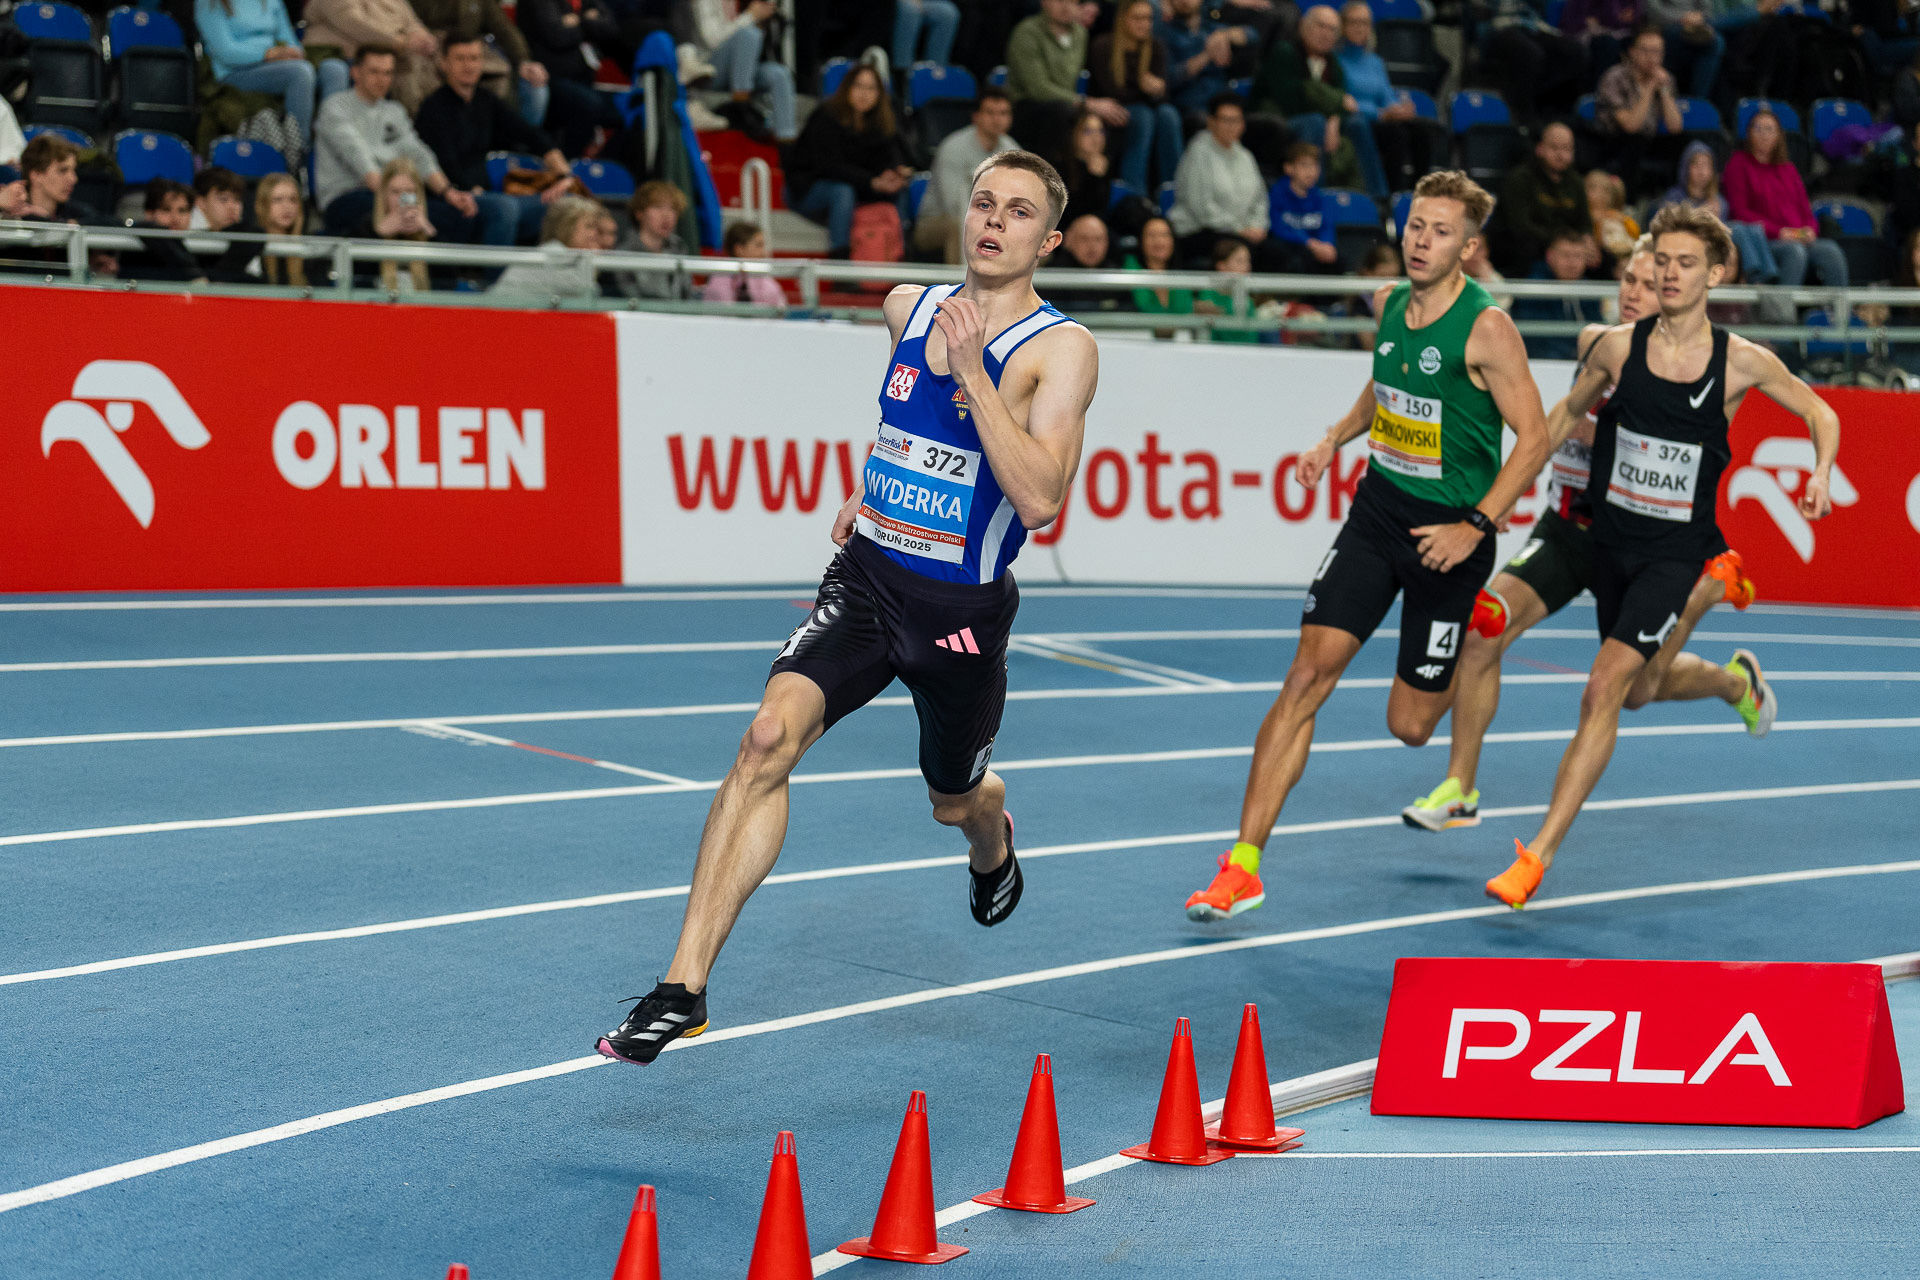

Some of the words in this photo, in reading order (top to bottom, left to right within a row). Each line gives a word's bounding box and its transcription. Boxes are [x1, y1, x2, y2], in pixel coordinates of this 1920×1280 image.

[1405, 398, 1433, 418] 150
[272, 400, 545, 490] ORLEN
[1658, 444, 1692, 464] 376
[923, 446, 967, 478] 372
[1618, 460, 1689, 493] CZUBAK
[866, 467, 963, 523] WYDERKA
[873, 527, 902, 546] TORUŃ
[903, 538, 932, 553] 2025
[896, 523, 939, 540] Mistrzostwa
[939, 533, 961, 545] Polski
[1436, 625, 1454, 655] 4
[1441, 1007, 1793, 1087] PZLA
